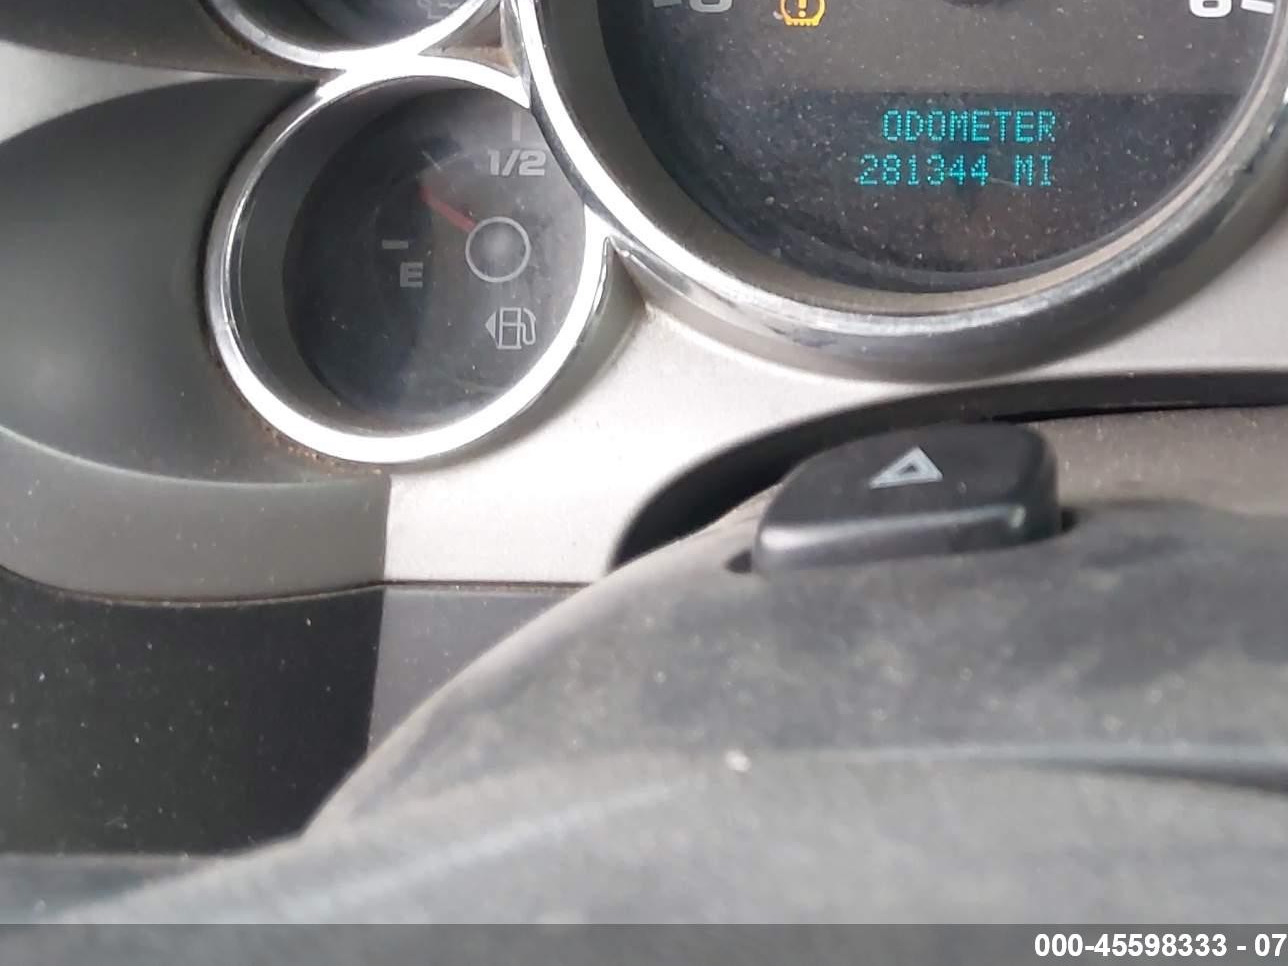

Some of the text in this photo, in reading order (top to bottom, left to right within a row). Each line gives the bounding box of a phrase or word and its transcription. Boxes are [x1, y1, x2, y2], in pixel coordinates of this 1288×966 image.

[884, 111, 1055, 142] ODOMETER
[489, 151, 546, 176] 1/2
[860, 155, 1051, 186] 281344 MI
[400, 262, 423, 287] E
